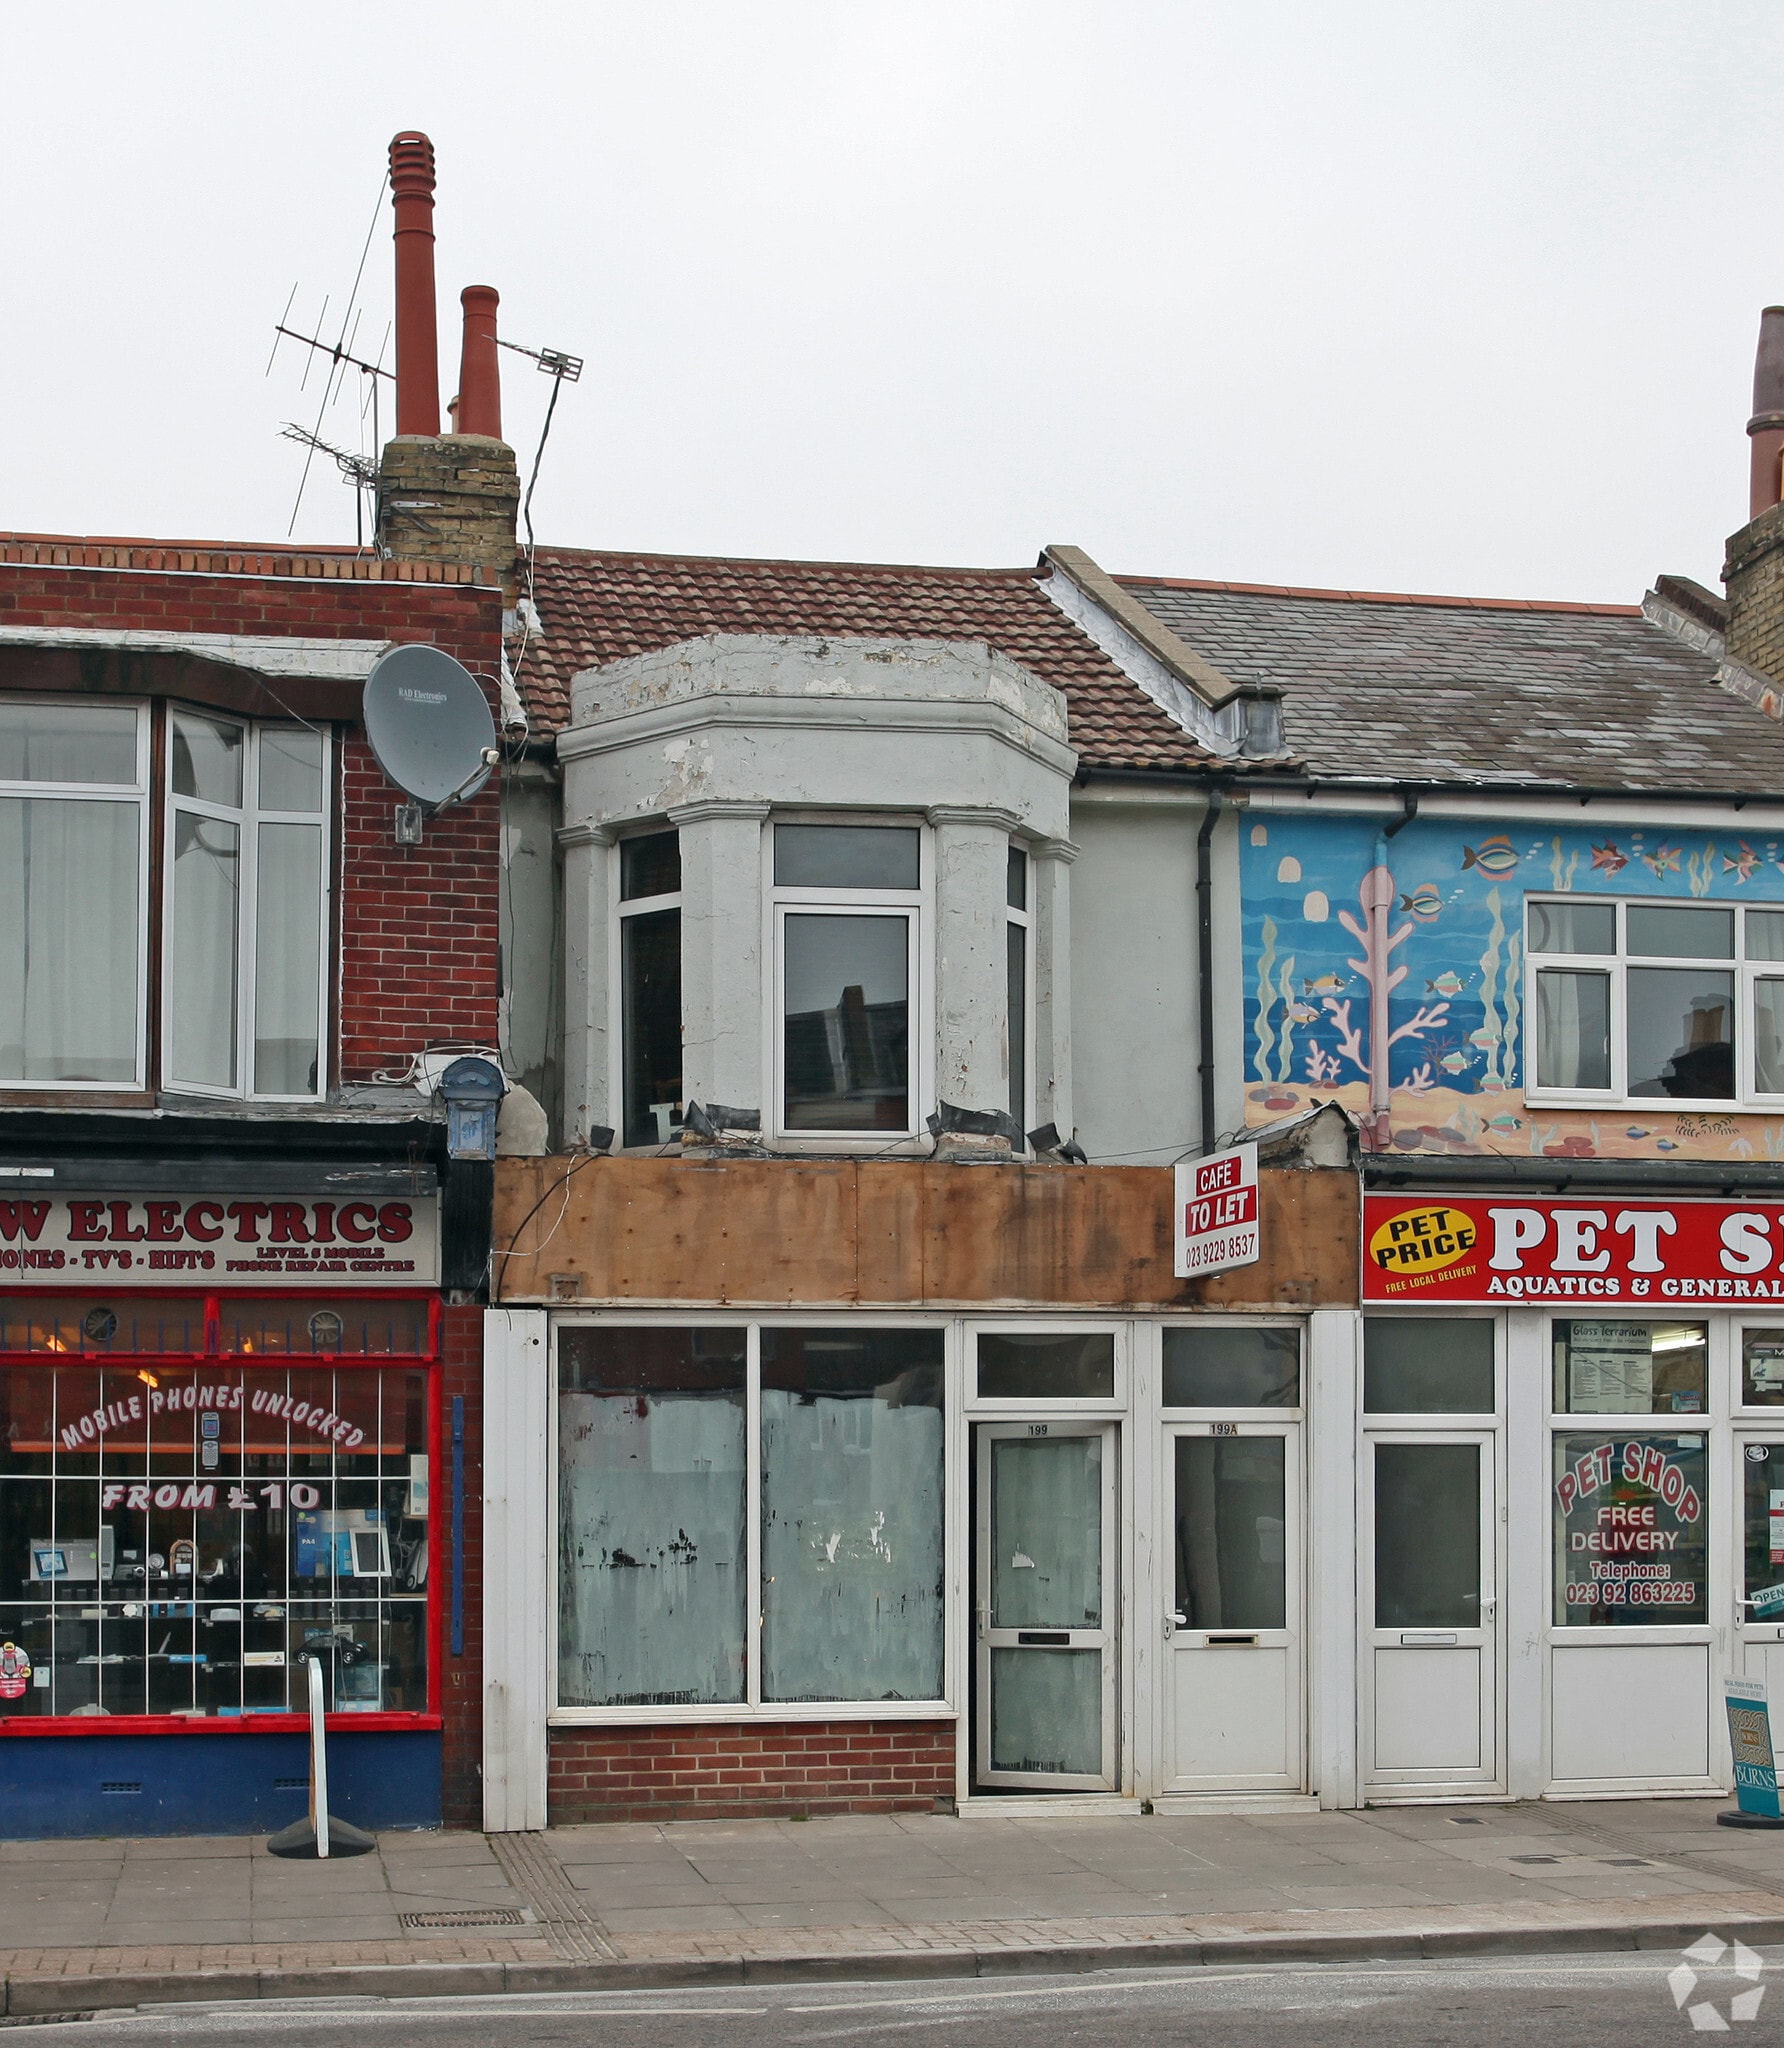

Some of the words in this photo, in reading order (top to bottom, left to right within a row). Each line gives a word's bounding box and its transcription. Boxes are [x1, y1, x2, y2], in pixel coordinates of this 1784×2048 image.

[1200, 1160, 1232, 1192] CAFÉ
[66, 1200, 414, 1243] ELECTRICS
[1190, 1201, 1211, 1232] TO
[1215, 1190, 1249, 1226] LET
[1389, 1210, 1450, 1242] PET
[1186, 1245, 1201, 1268] 023
[1203, 1239, 1226, 1264] 9229
[1229, 1233, 1255, 1258] 8537
[1376, 1228, 1477, 1269] PRICE
[1487, 1206, 1678, 1274] PET
[1719, 1211, 1784, 1275] S
[0, 1249, 66, 1270] ONES
[82, 1249, 132, 1270] TV'S
[148, 1249, 216, 1270] HIFI'S
[256, 1247, 309, 1259] LEVEL
[324, 1247, 385, 1259] MOBILE
[226, 1260, 283, 1272] PHONE
[285, 1260, 347, 1272] REPAIR
[350, 1260, 415, 1272] CENTRE
[1385, 1280, 1407, 1293] FREE
[1409, 1274, 1436, 1288] LOCAL
[1438, 1264, 1478, 1282] DELIVERY
[1486, 1276, 1621, 1299] AQUATICS
[1631, 1277, 1651, 1297] &
[1661, 1278, 1784, 1298] GENERAL
[1601, 1325, 1647, 1337] Terrarium
[61, 1396, 143, 1451] MOBILE
[151, 1385, 244, 1414] PHONES
[251, 1389, 365, 1449] UNLOCKED
[1029, 1424, 1048, 1436] 199
[1211, 1423, 1238, 1436] 199A
[1555, 1443, 1615, 1518] PET
[1622, 1441, 1701, 1523] SHOP
[102, 1484, 218, 1510] FROM
[228, 1483, 319, 1510] £10
[1597, 1506, 1654, 1526] FREE
[1571, 1531, 1679, 1551] DELIVERY
[1590, 1561, 1671, 1583] Telephone:
[1565, 1582, 1599, 1605] 023
[1602, 1582, 1626, 1605] 92
[1630, 1581, 1696, 1605] 863225
[1735, 1765, 1776, 1789] BURNS
